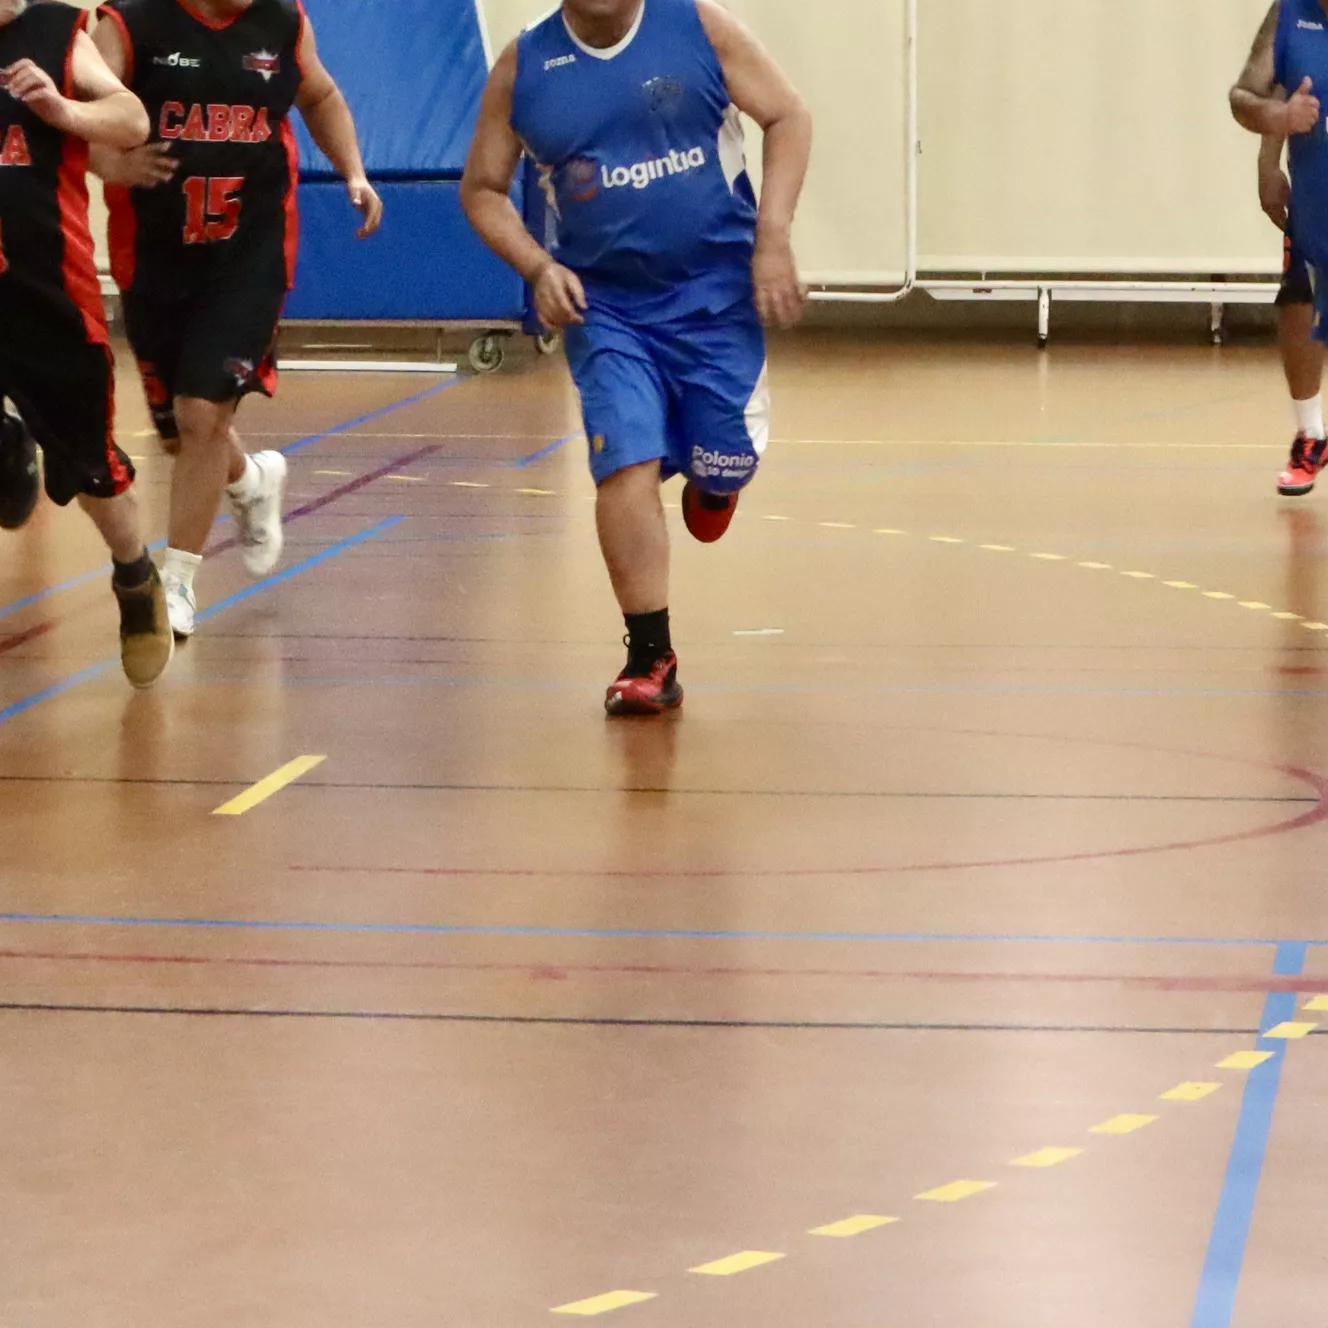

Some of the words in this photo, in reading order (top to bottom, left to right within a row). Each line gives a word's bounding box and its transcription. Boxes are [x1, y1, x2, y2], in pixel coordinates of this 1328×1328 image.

[159, 101, 272, 143] CABRA
[182, 175, 246, 244] 15
[692, 444, 755, 468] Polonio
